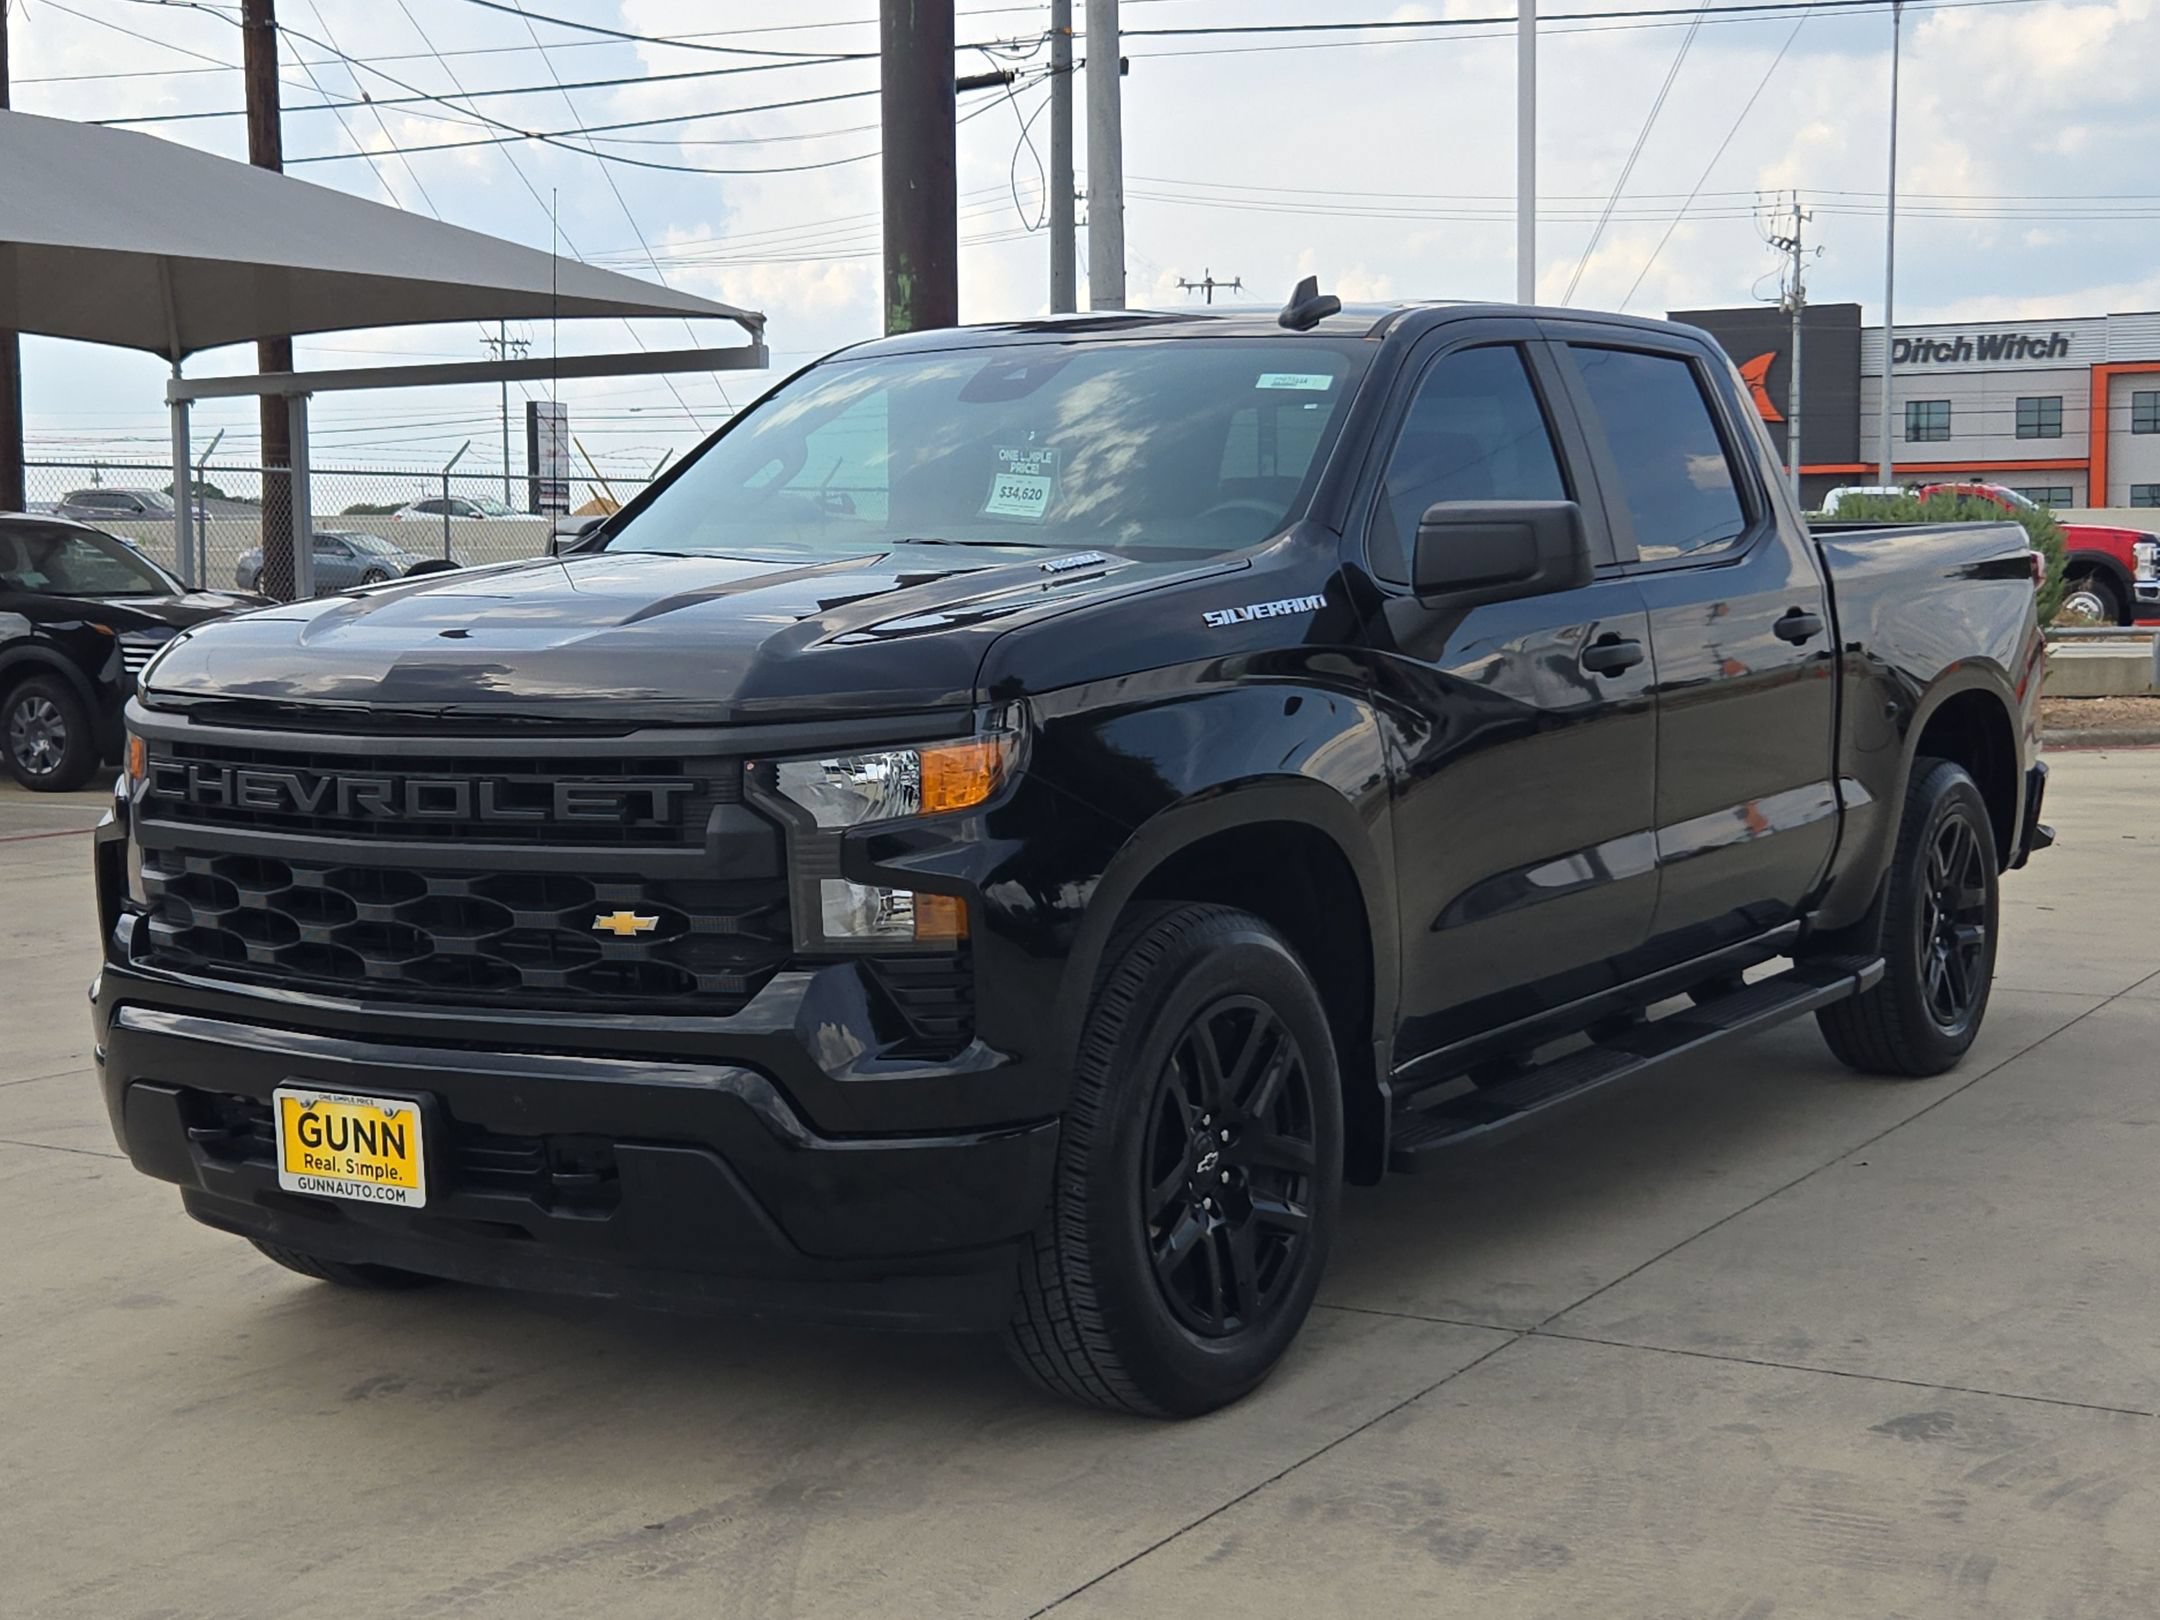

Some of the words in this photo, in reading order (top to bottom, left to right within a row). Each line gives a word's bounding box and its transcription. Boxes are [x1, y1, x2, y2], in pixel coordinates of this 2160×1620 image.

[1892, 336, 1973, 364] Ditch
[1976, 331, 2069, 361] Witch
[999, 449, 1019, 461] ONE
[999, 485, 1043, 501] $34,620
[1202, 593, 1328, 628] SILVERADO
[148, 760, 695, 824] CHEVROLET
[297, 1111, 406, 1160] GUNN
[304, 1153, 341, 1172] Real.
[297, 1176, 407, 1203] GUNNAUTO.COM
